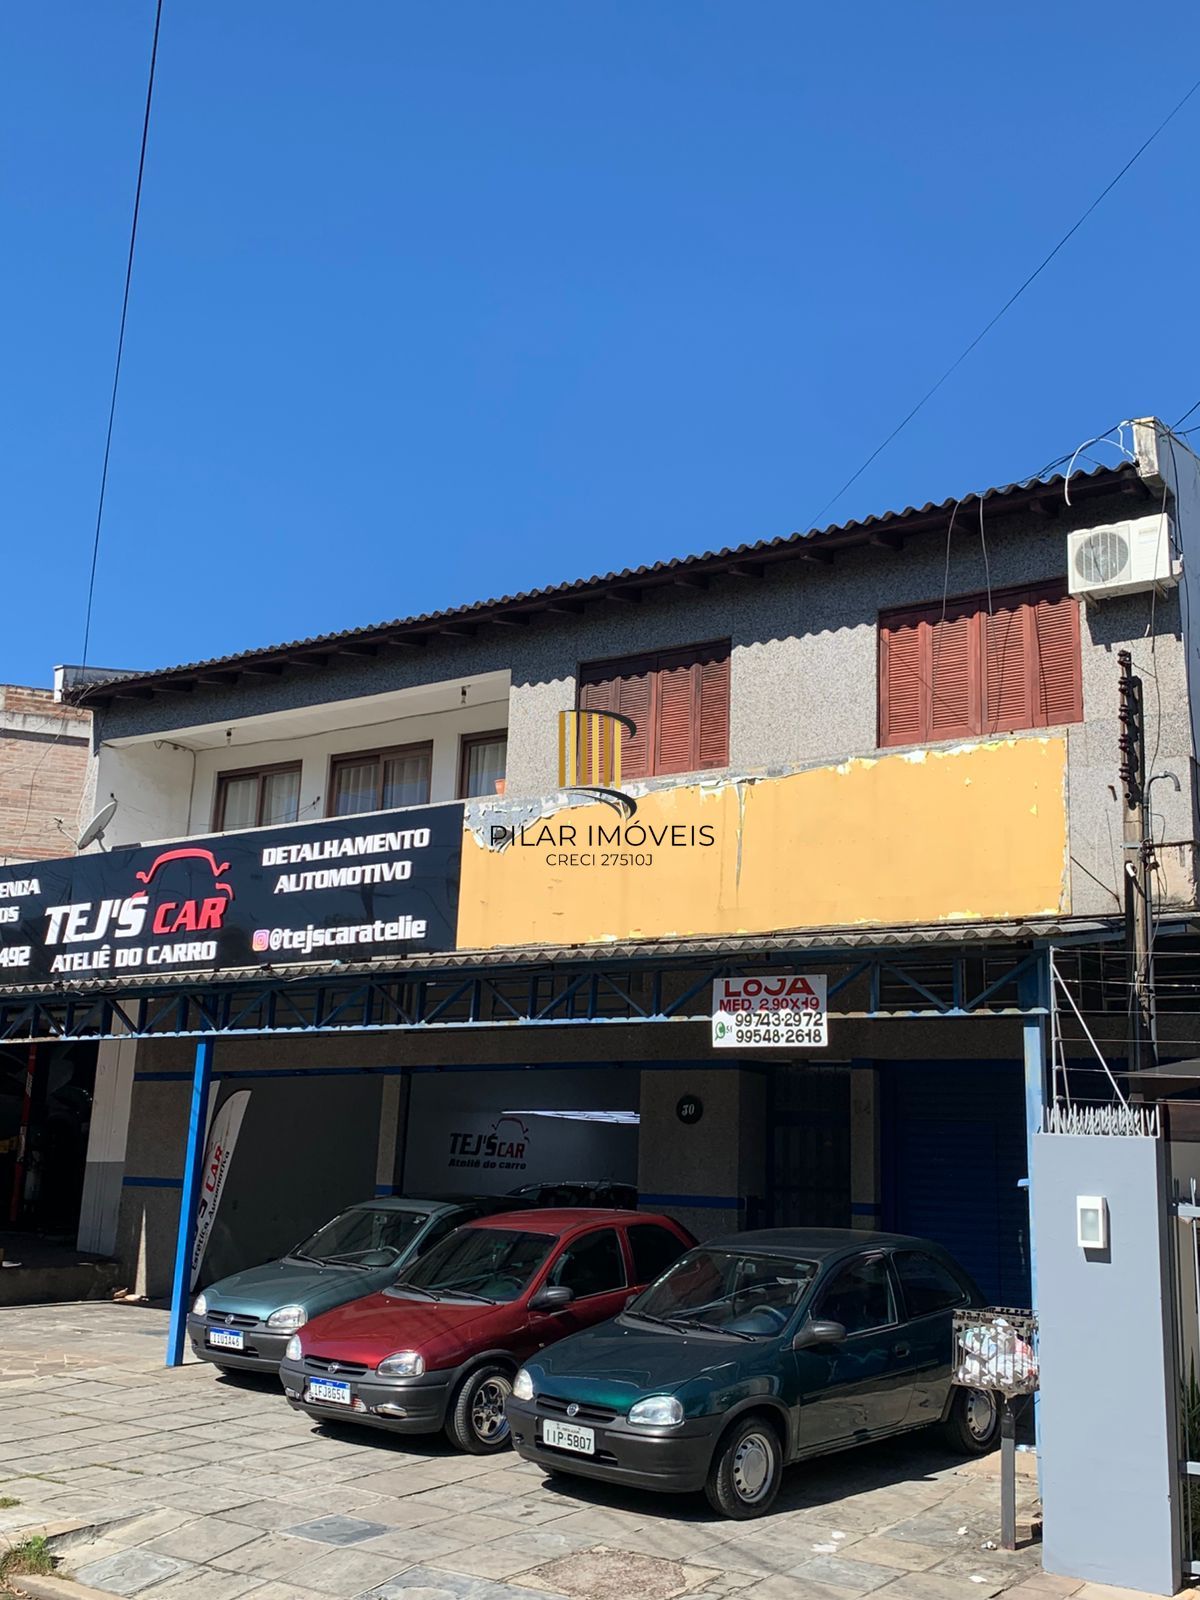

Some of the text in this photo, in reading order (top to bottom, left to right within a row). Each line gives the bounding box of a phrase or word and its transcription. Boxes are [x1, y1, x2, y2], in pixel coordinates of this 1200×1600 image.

[262, 828, 431, 866] DETALHAMENTO
[273, 860, 412, 894] AUTOMOTIVO
[44, 896, 227, 945] TEJ'S CAR
[269, 914, 427, 954] @tejscaratelie
[50, 940, 218, 973] ATELIÊ DO CARRO
[724, 977, 816, 998] LOJA
[719, 998, 754, 1012] MED.
[450, 1132, 525, 1158] TEJ'S CAR
[205, 1145, 223, 1193] CAR
[483, 1160, 497, 1169] do
[499, 1161, 527, 1170] carro
